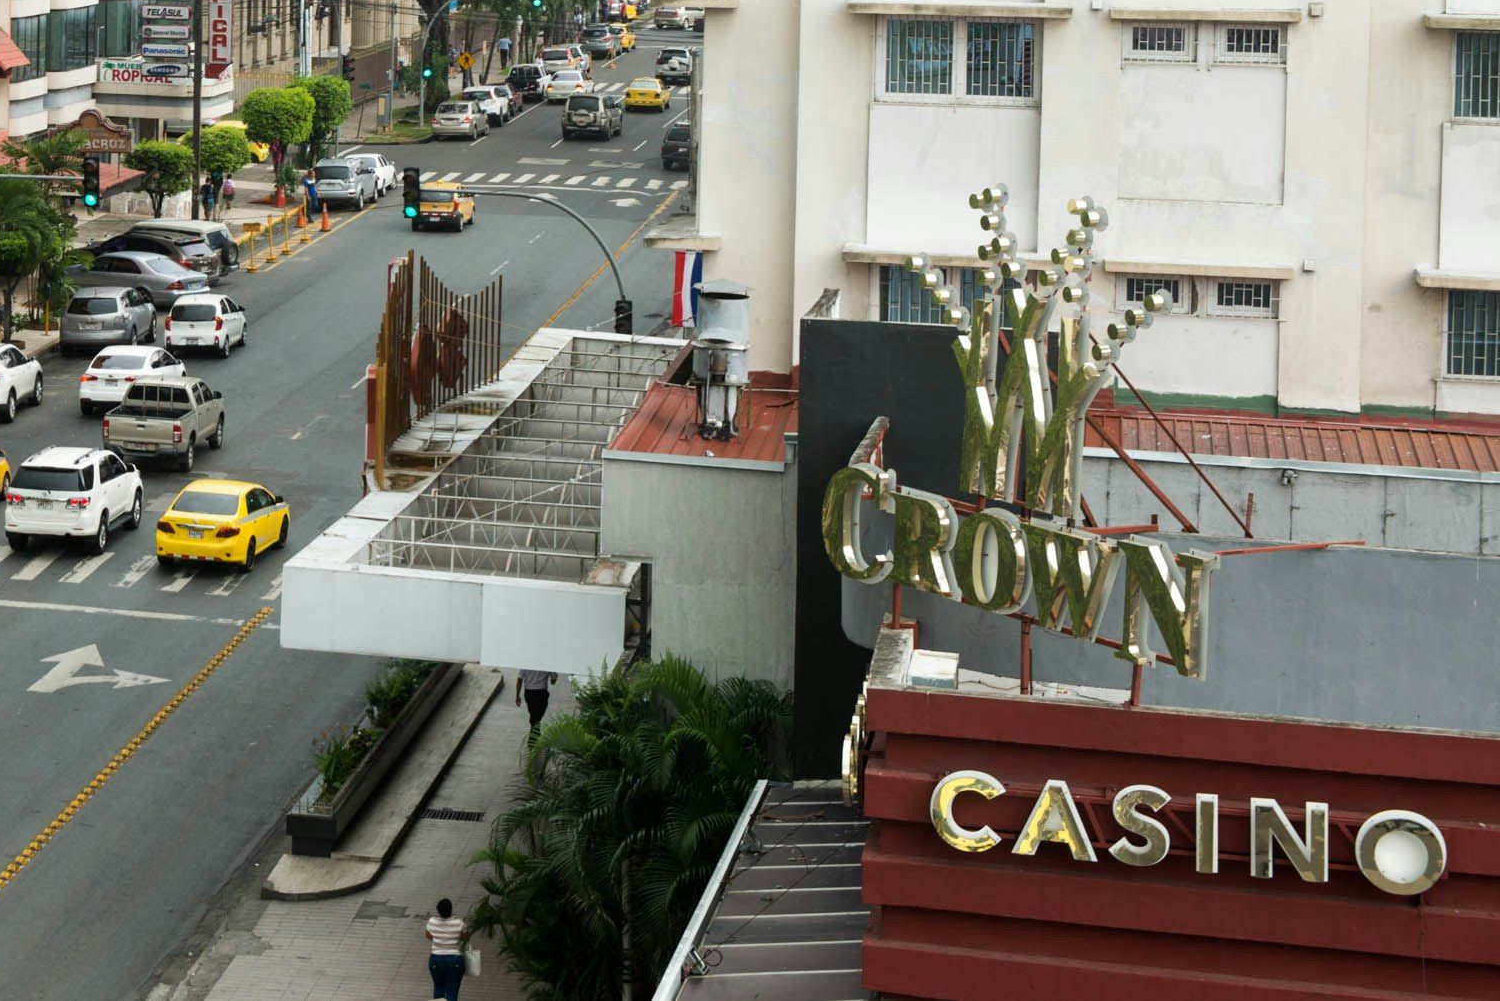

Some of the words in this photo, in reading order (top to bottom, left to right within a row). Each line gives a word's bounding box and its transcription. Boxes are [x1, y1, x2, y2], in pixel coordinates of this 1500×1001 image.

[147, 8, 183, 17] TELASUL
[822, 463, 1220, 681] CROWN
[929, 770, 1447, 896] CASINO
